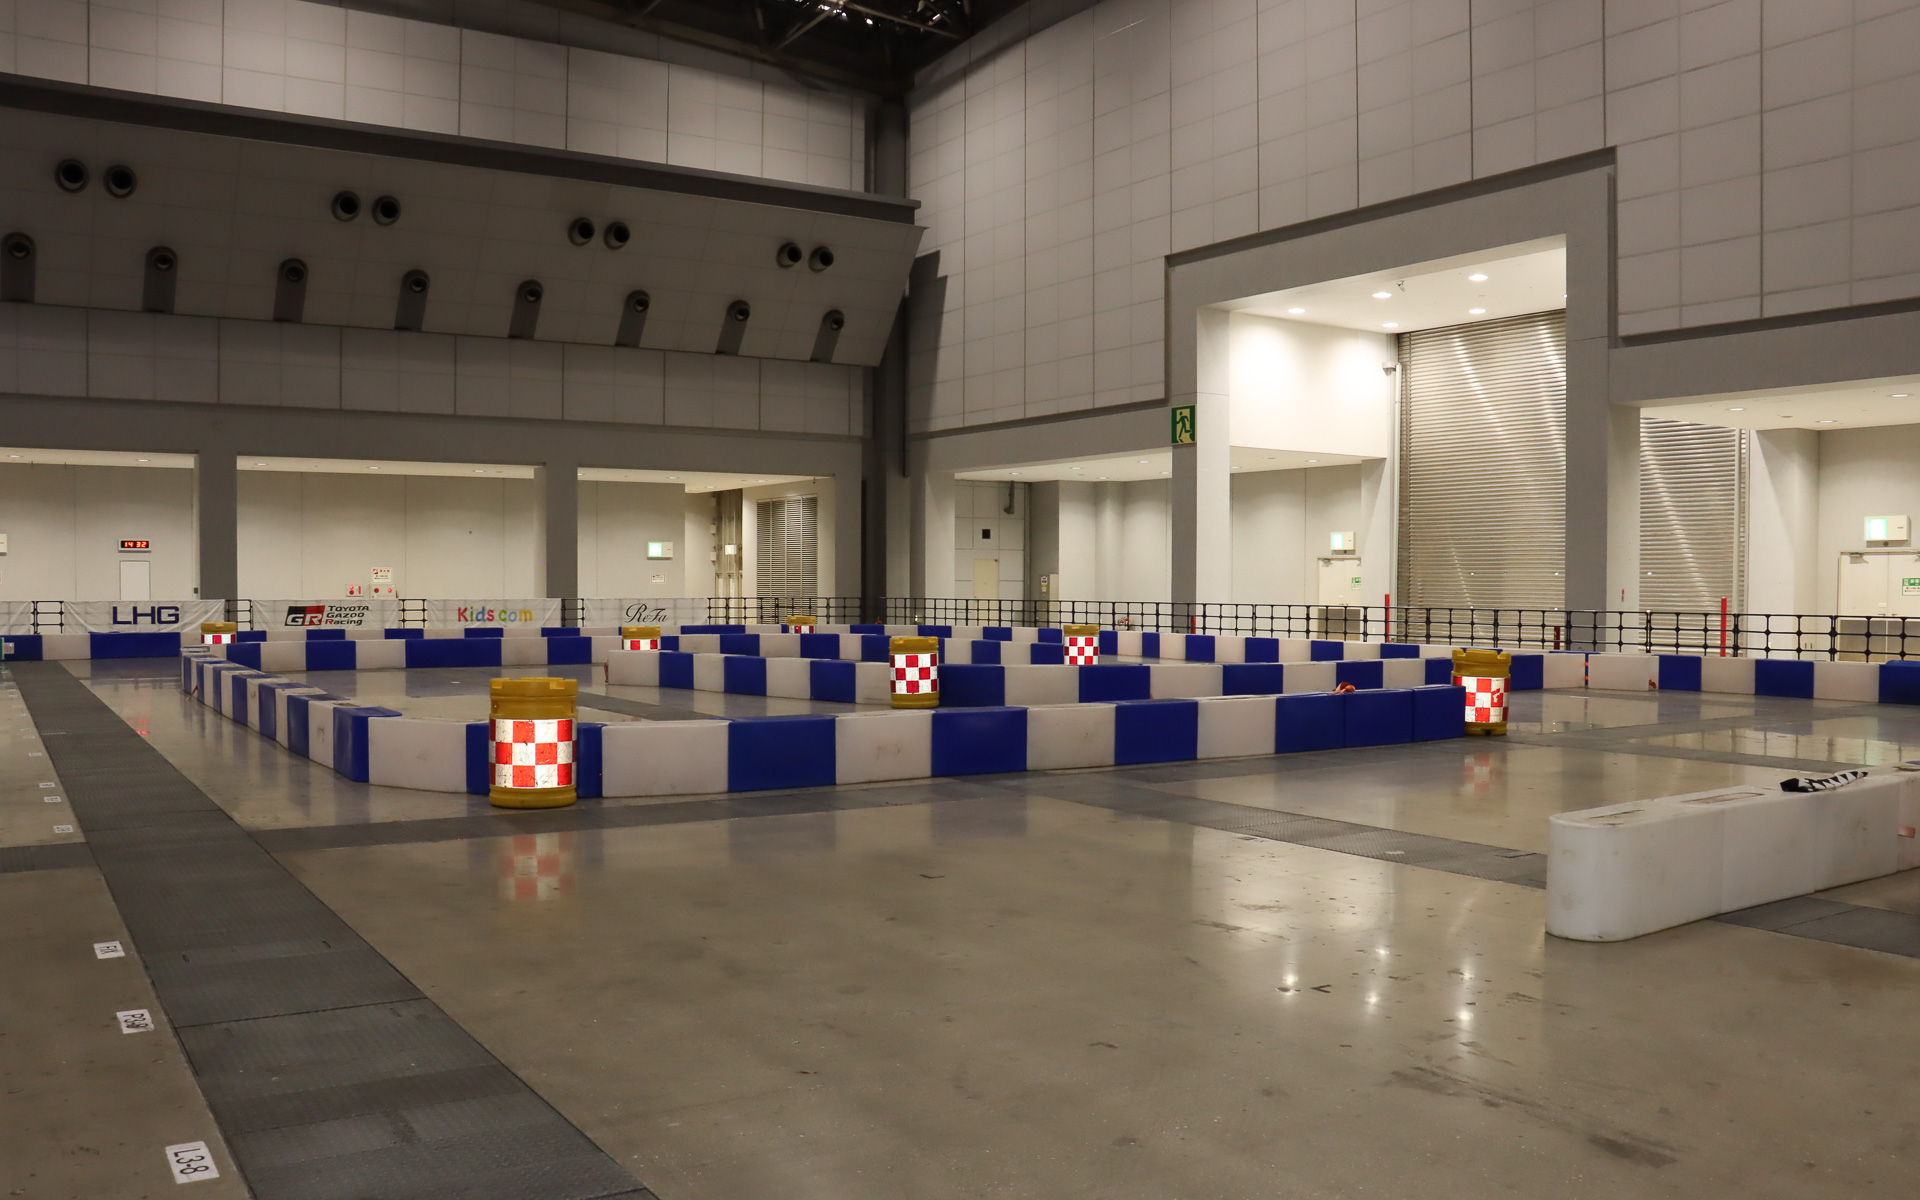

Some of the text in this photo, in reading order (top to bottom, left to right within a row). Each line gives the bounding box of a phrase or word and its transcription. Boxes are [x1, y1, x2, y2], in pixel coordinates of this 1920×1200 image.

[112, 606, 180, 625] LHG
[286, 613, 323, 626] GR
[325, 618, 363, 627] Racing
